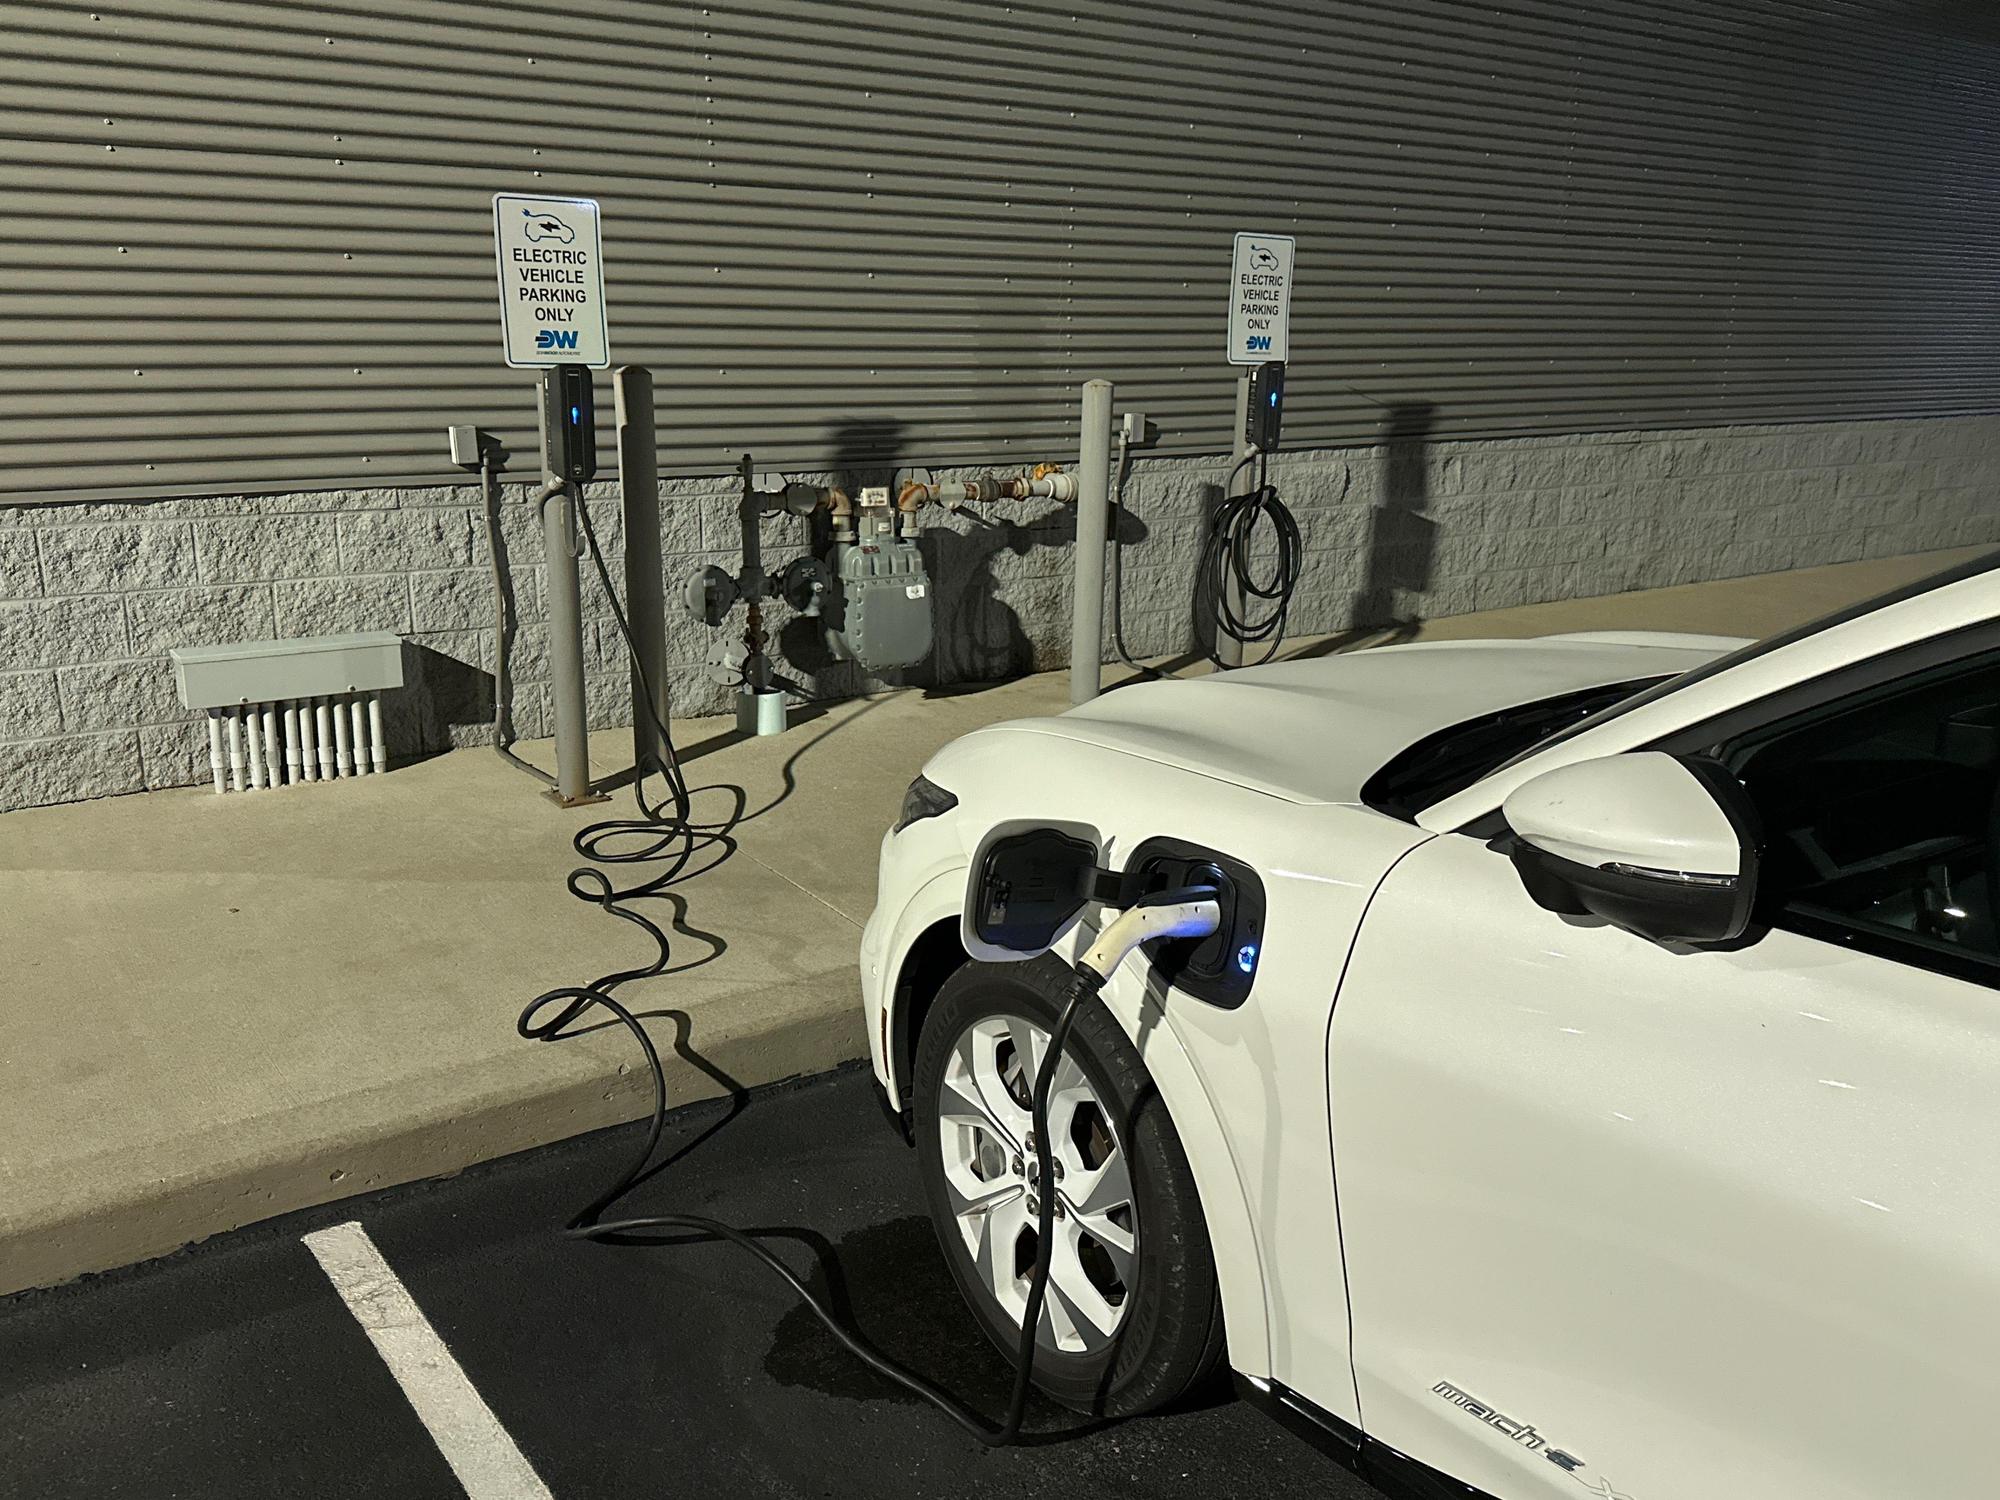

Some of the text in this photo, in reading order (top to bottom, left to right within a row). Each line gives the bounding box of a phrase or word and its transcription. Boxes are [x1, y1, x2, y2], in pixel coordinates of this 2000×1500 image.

[513, 248, 587, 264] ELECTRIC
[519, 268, 584, 284] VEHICLE
[1241, 274, 1283, 287] ELECTRIC
[519, 288, 586, 303] PARKING
[1243, 289, 1279, 301] VEHICLE
[535, 307, 574, 322] ONLY
[1241, 304, 1279, 315] PARKING
[1248, 319, 1271, 330] ONLY
[535, 330, 579, 349] DW
